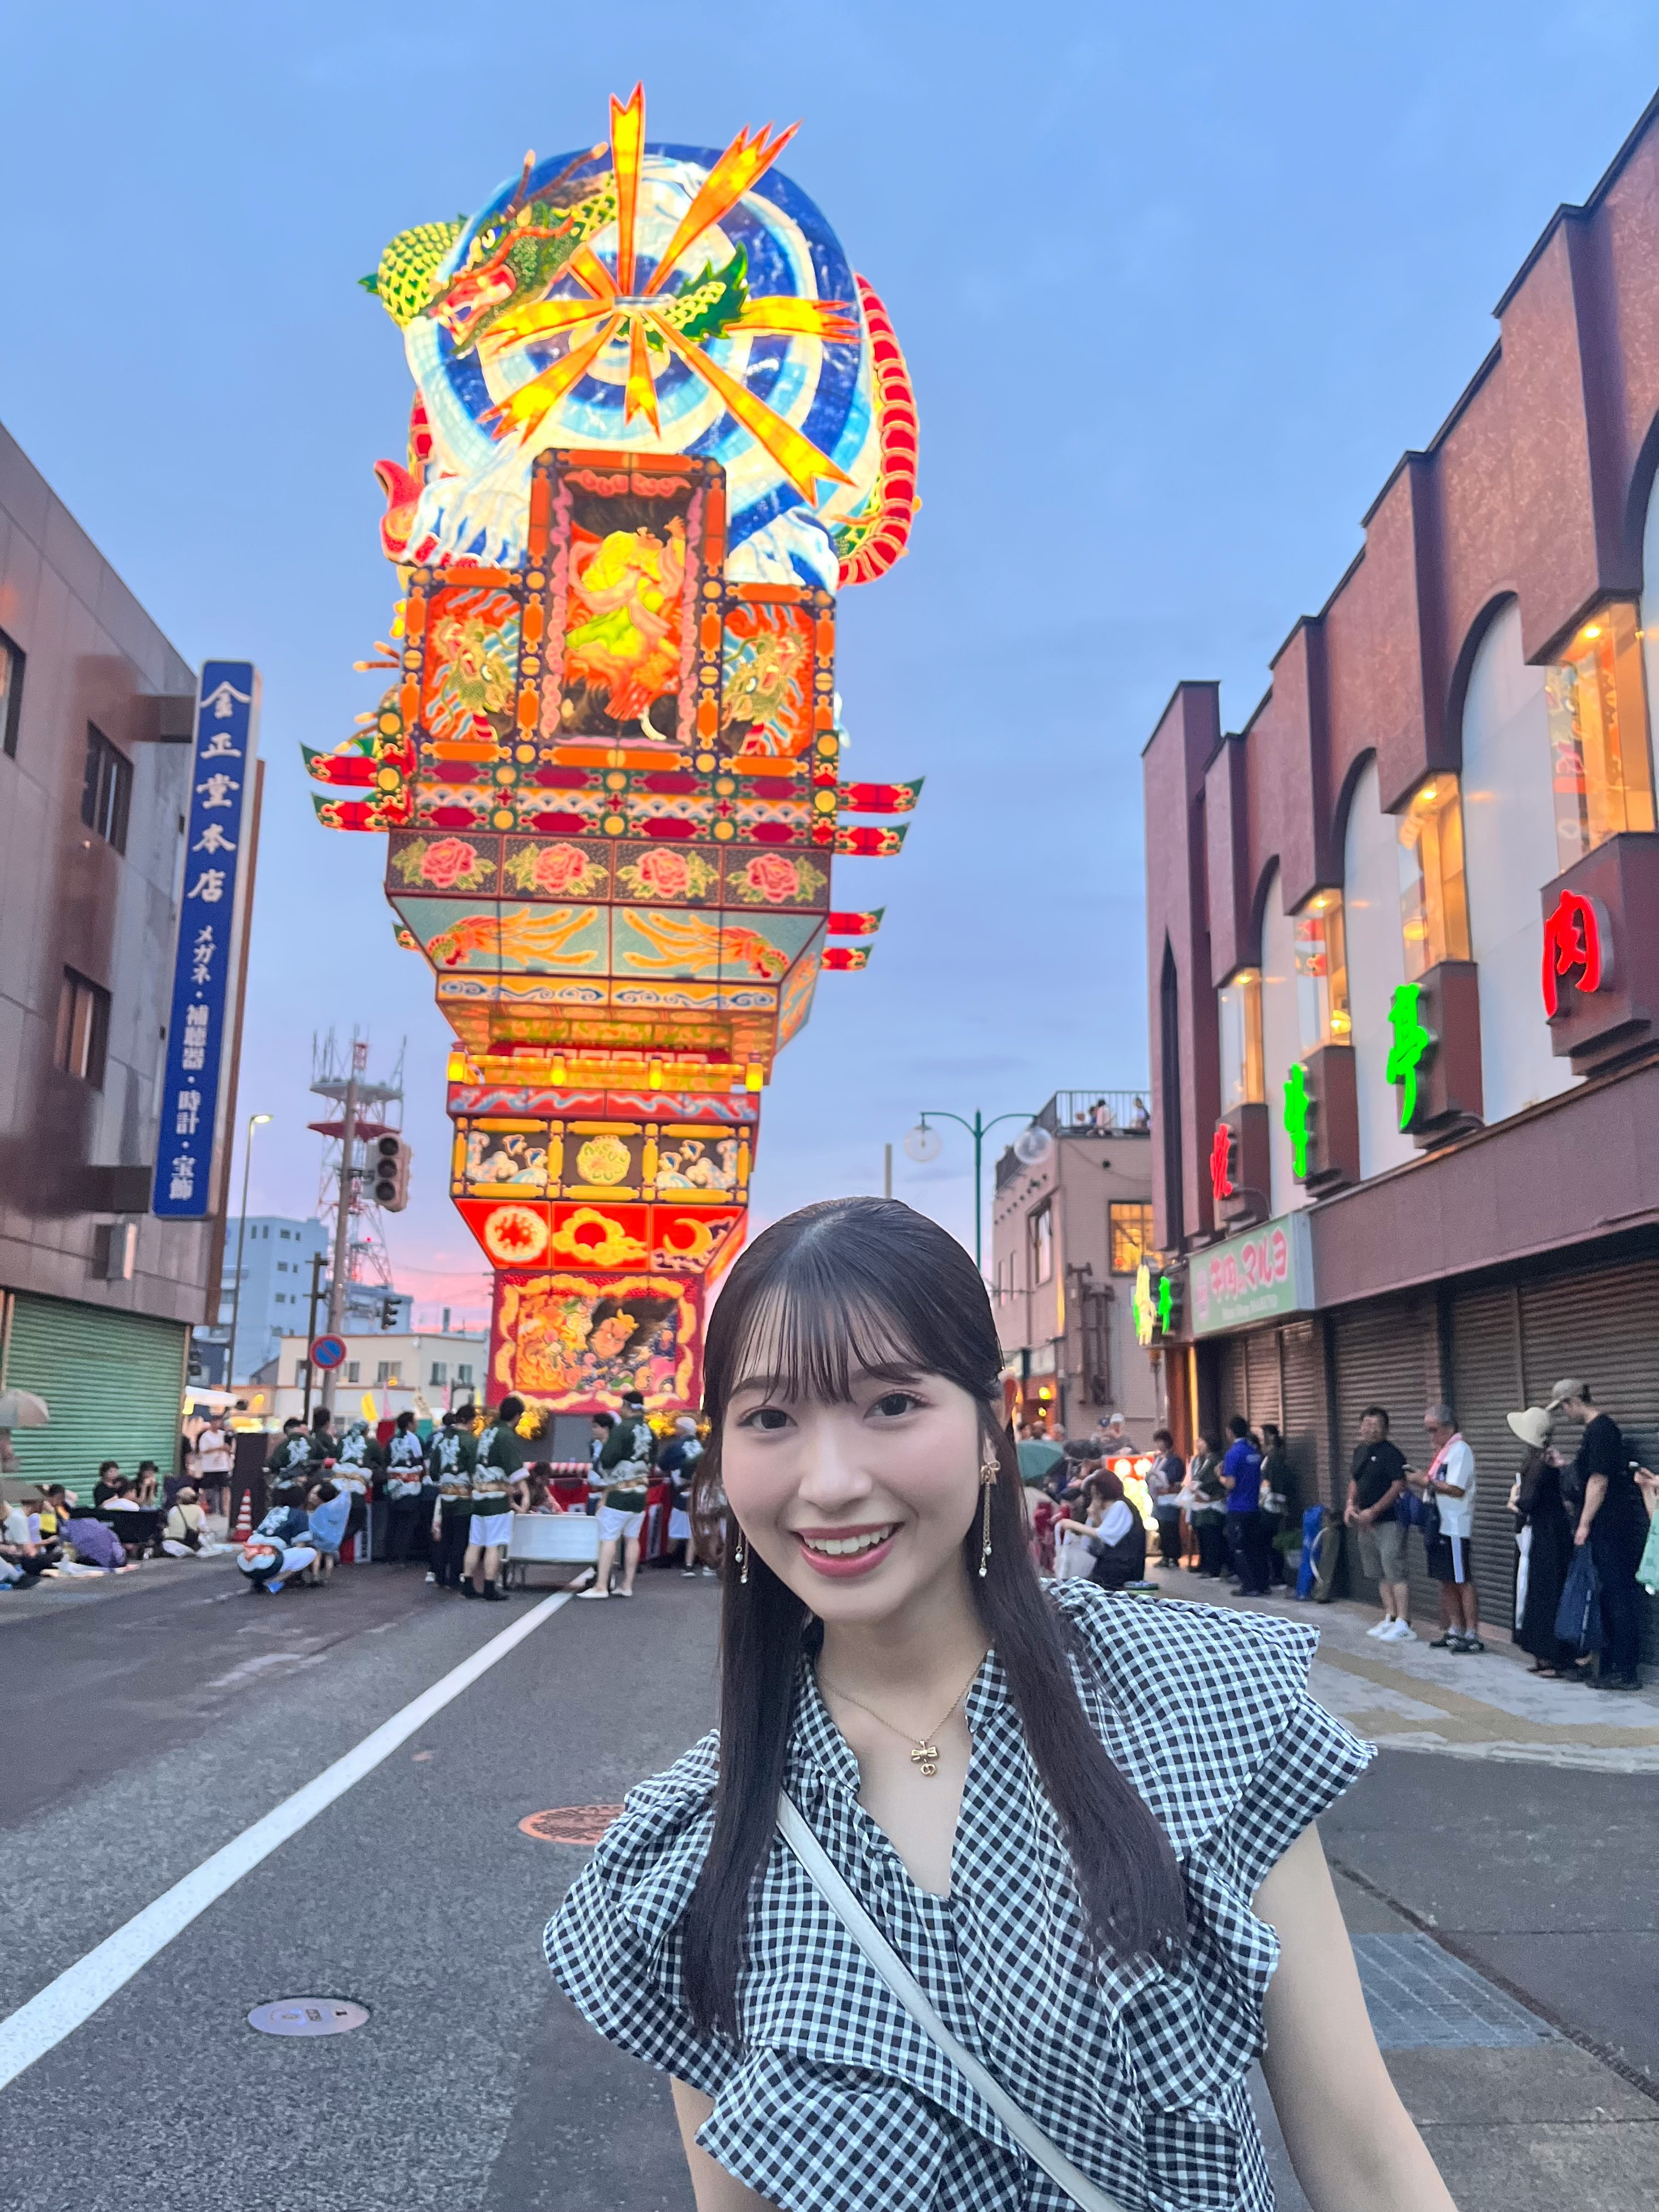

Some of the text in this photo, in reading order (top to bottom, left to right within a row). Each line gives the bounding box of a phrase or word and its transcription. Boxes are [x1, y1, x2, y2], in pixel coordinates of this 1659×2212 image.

[187, 681, 251, 904] 金正堂本店
